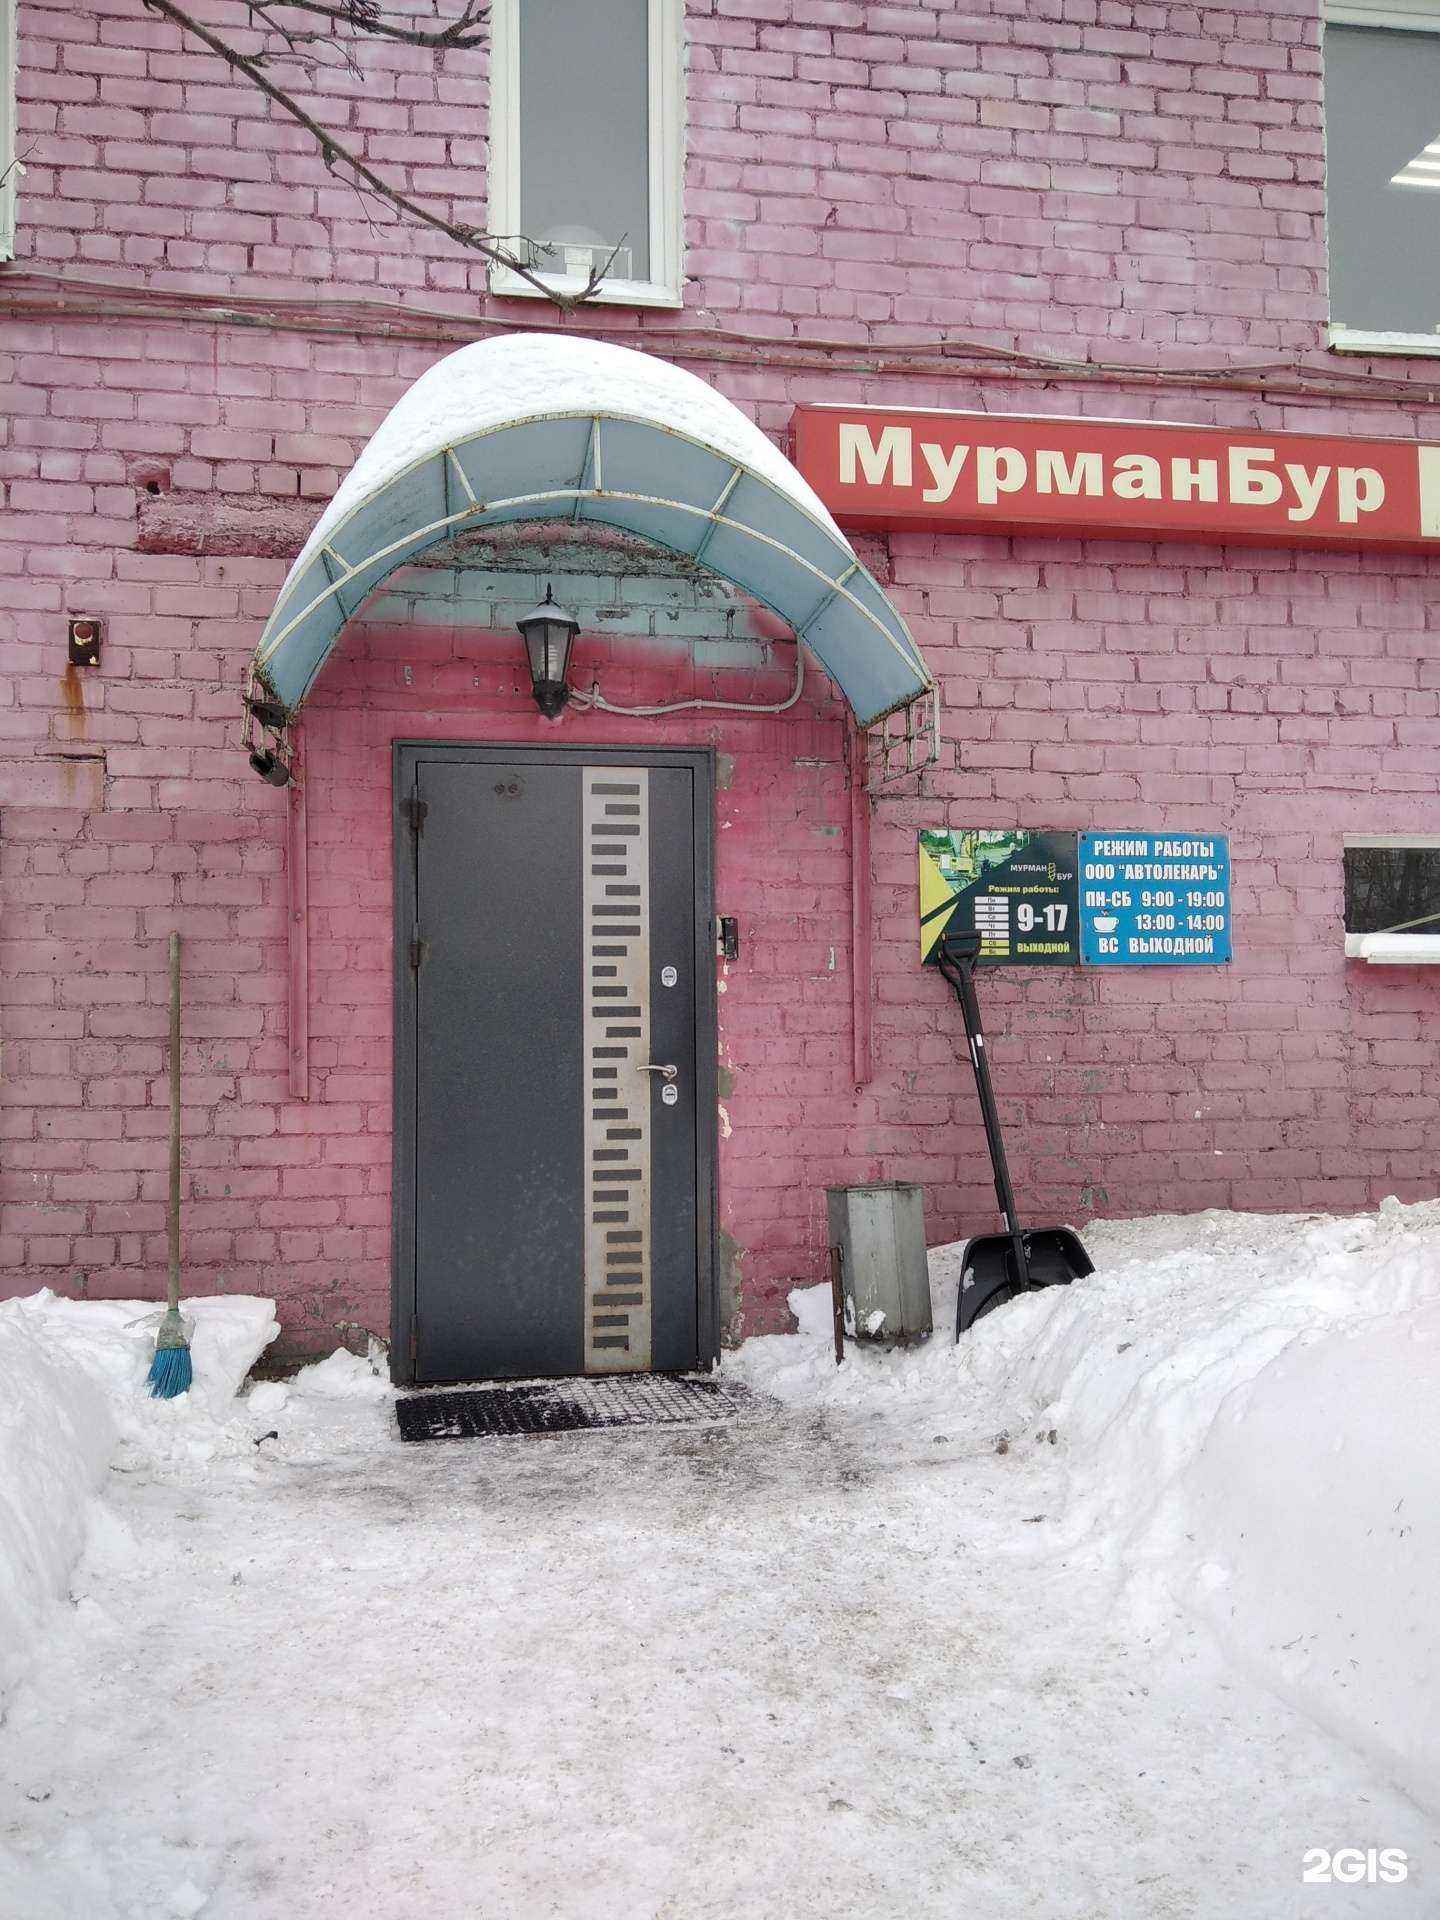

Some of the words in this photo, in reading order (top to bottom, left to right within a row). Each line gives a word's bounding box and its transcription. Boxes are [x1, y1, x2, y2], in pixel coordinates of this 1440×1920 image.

[838, 423, 1385, 524] МурманБур
[1094, 840, 1148, 856] РЕЖИМ
[1154, 841, 1214, 857] РАБОТЫ
[1010, 864, 1047, 872] МУРМАН
[1085, 863, 1115, 880] ООО
[988, 884, 1020, 893] Режим
[1022, 885, 1060, 894] работы:
[1085, 891, 1132, 907] ПН-СБ
[1142, 891, 1175, 907] 9:00
[1186, 892, 1225, 907] 19:00
[1017, 903, 1069, 932] 9-17
[1135, 914, 1175, 930] 13:00
[1186, 914, 1225, 930] 14:00
[1098, 938, 1119, 953] ВС
[1129, 934, 1214, 956] ВЫХОДНОЙ
